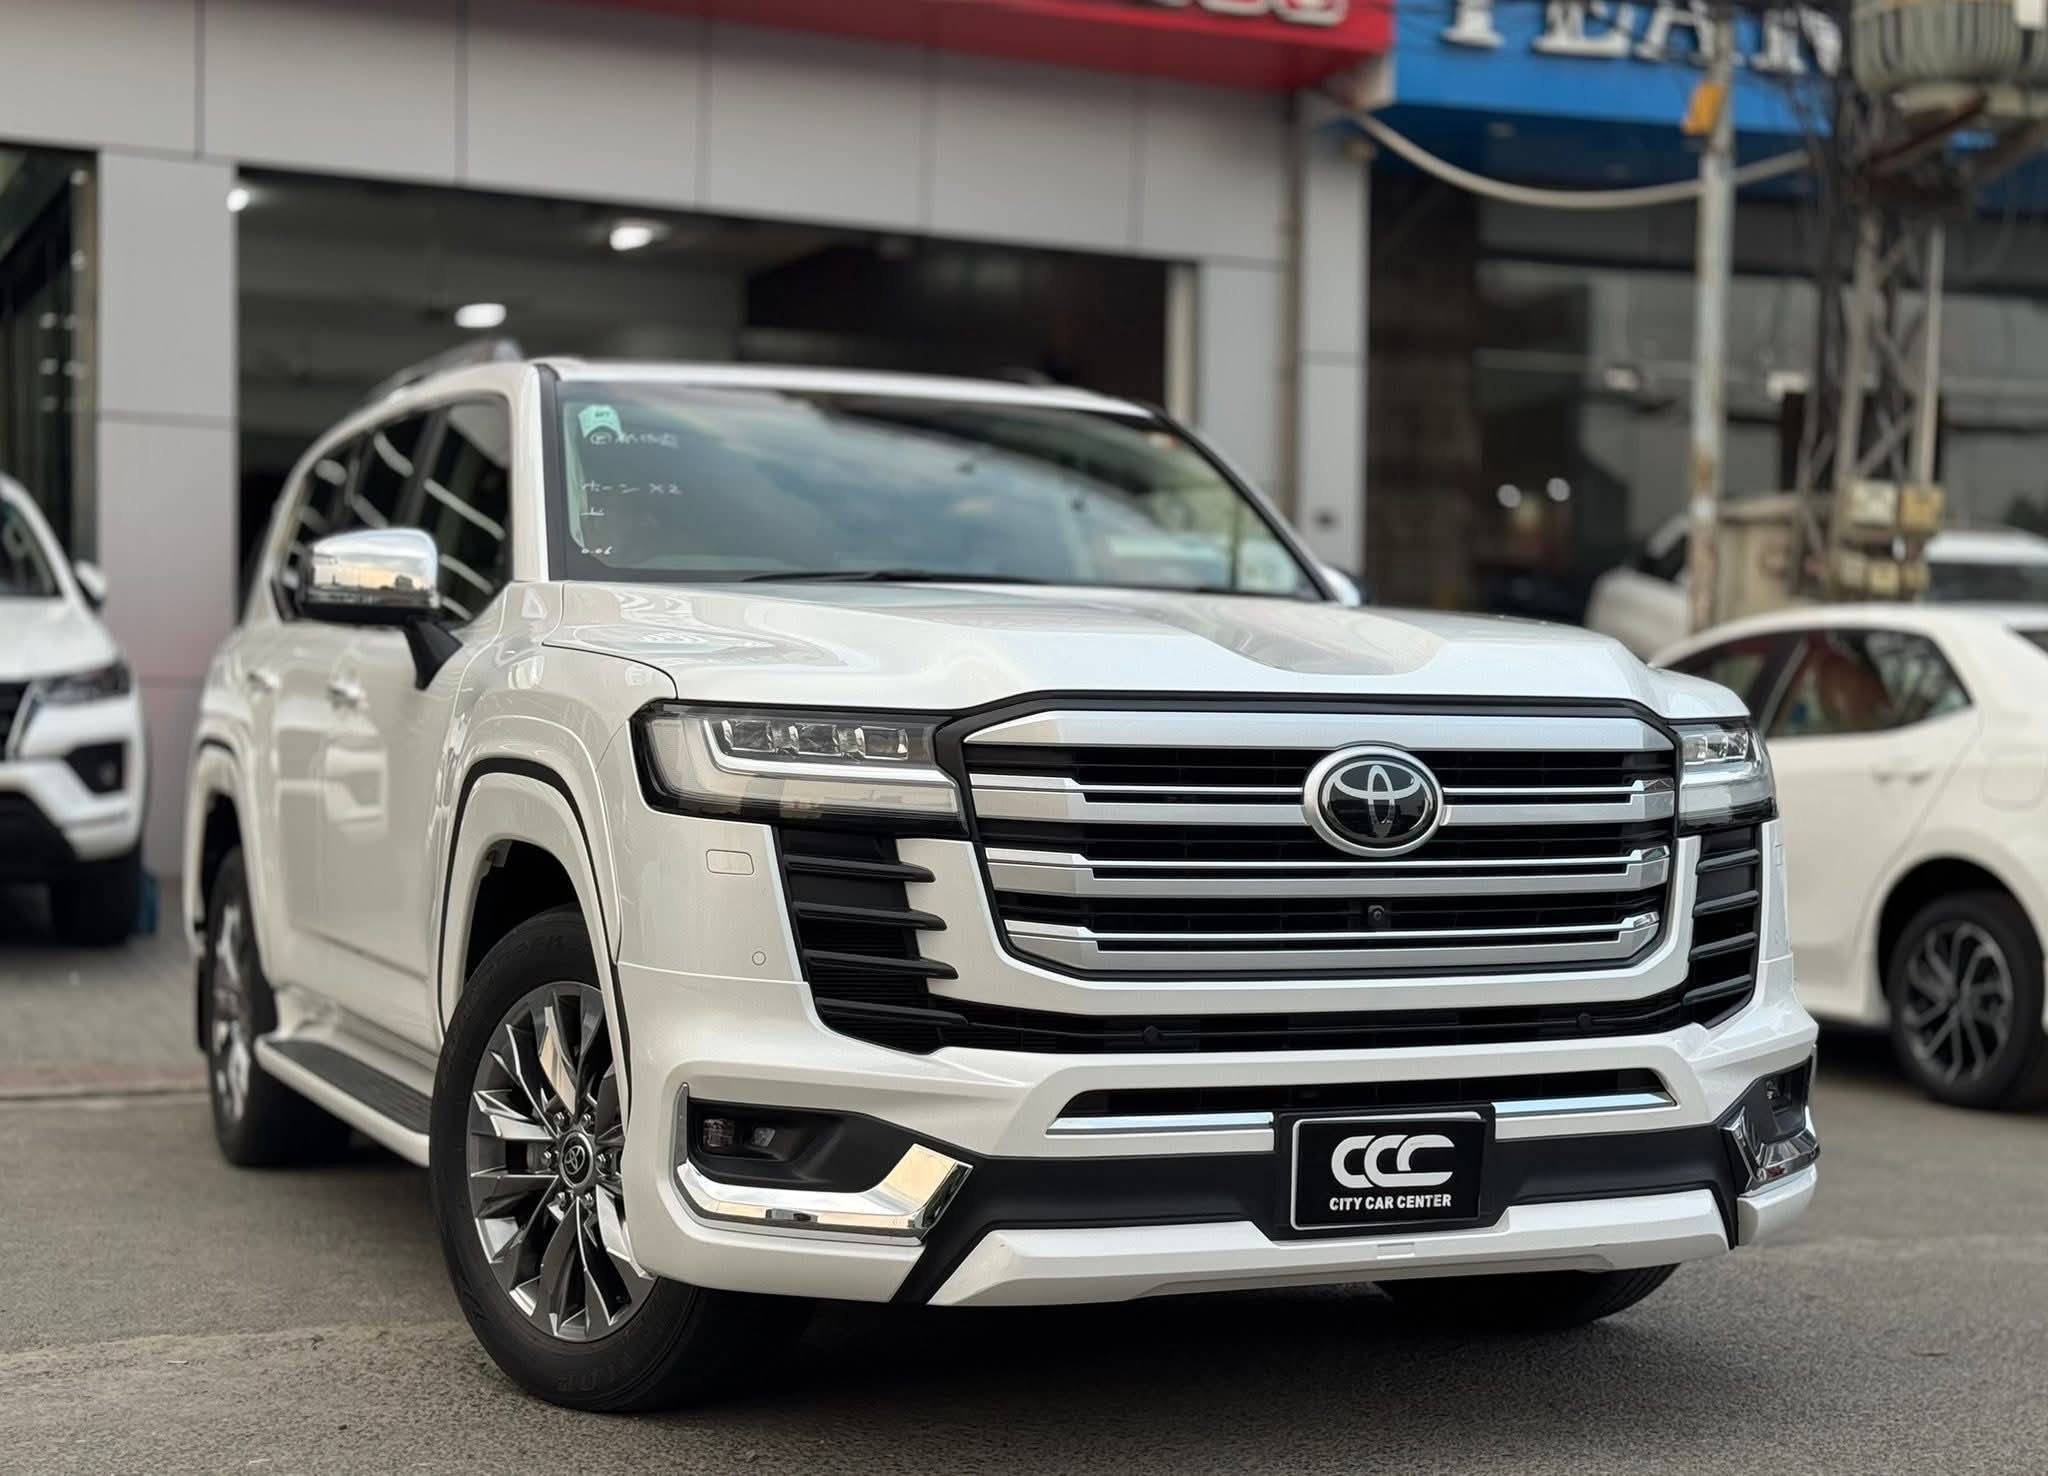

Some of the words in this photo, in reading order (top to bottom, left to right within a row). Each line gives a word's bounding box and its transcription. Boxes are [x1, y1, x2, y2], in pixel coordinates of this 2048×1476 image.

[1331, 1134, 1455, 1189] CCC
[1329, 1197, 1363, 1211] CITY
[1365, 1196, 1394, 1210] CAR
[1397, 1194, 1452, 1208] CENTER
